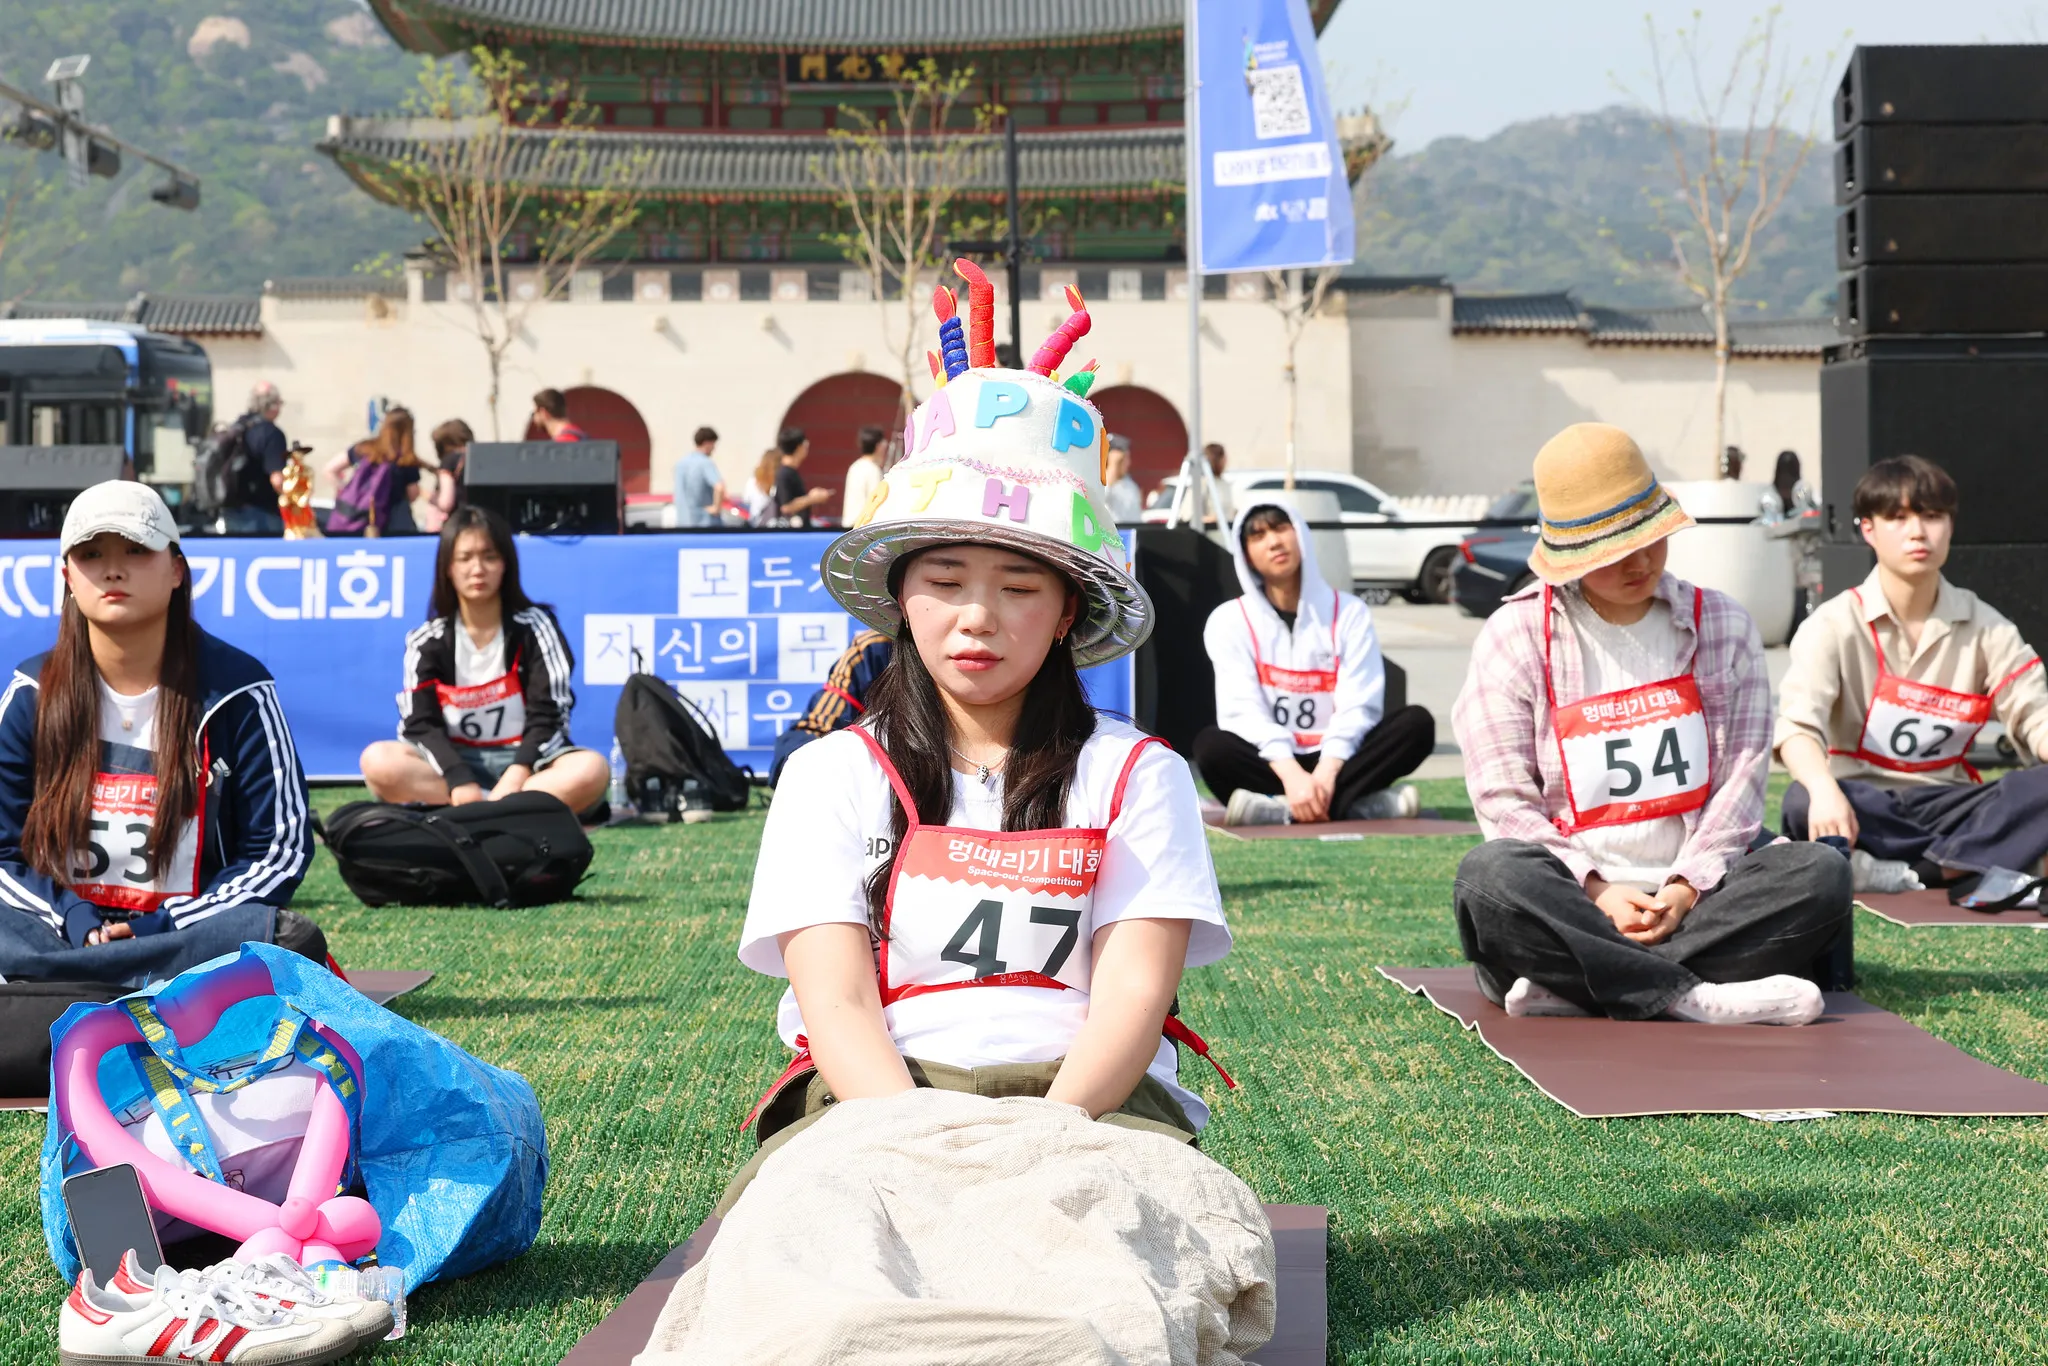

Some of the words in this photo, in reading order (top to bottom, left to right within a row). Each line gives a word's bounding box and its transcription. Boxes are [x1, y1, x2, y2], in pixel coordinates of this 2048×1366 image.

[690, 557, 825, 608] 모두
[597, 622, 757, 675] 자신의
[460, 705, 505, 739] 67
[1273, 696, 1315, 730] 68
[1582, 695, 1647, 722] 멍때리기
[1648, 688, 1681, 708] 대회
[1890, 718, 1953, 758] 62
[1604, 726, 1691, 798] 54
[73, 820, 155, 884] 53
[948, 839, 1050, 874] 멍때리기
[1058, 848, 1103, 876] 대회
[967, 865, 1020, 882] Space-out
[1021, 875, 1083, 888] Competition
[940, 899, 1083, 979] 47
